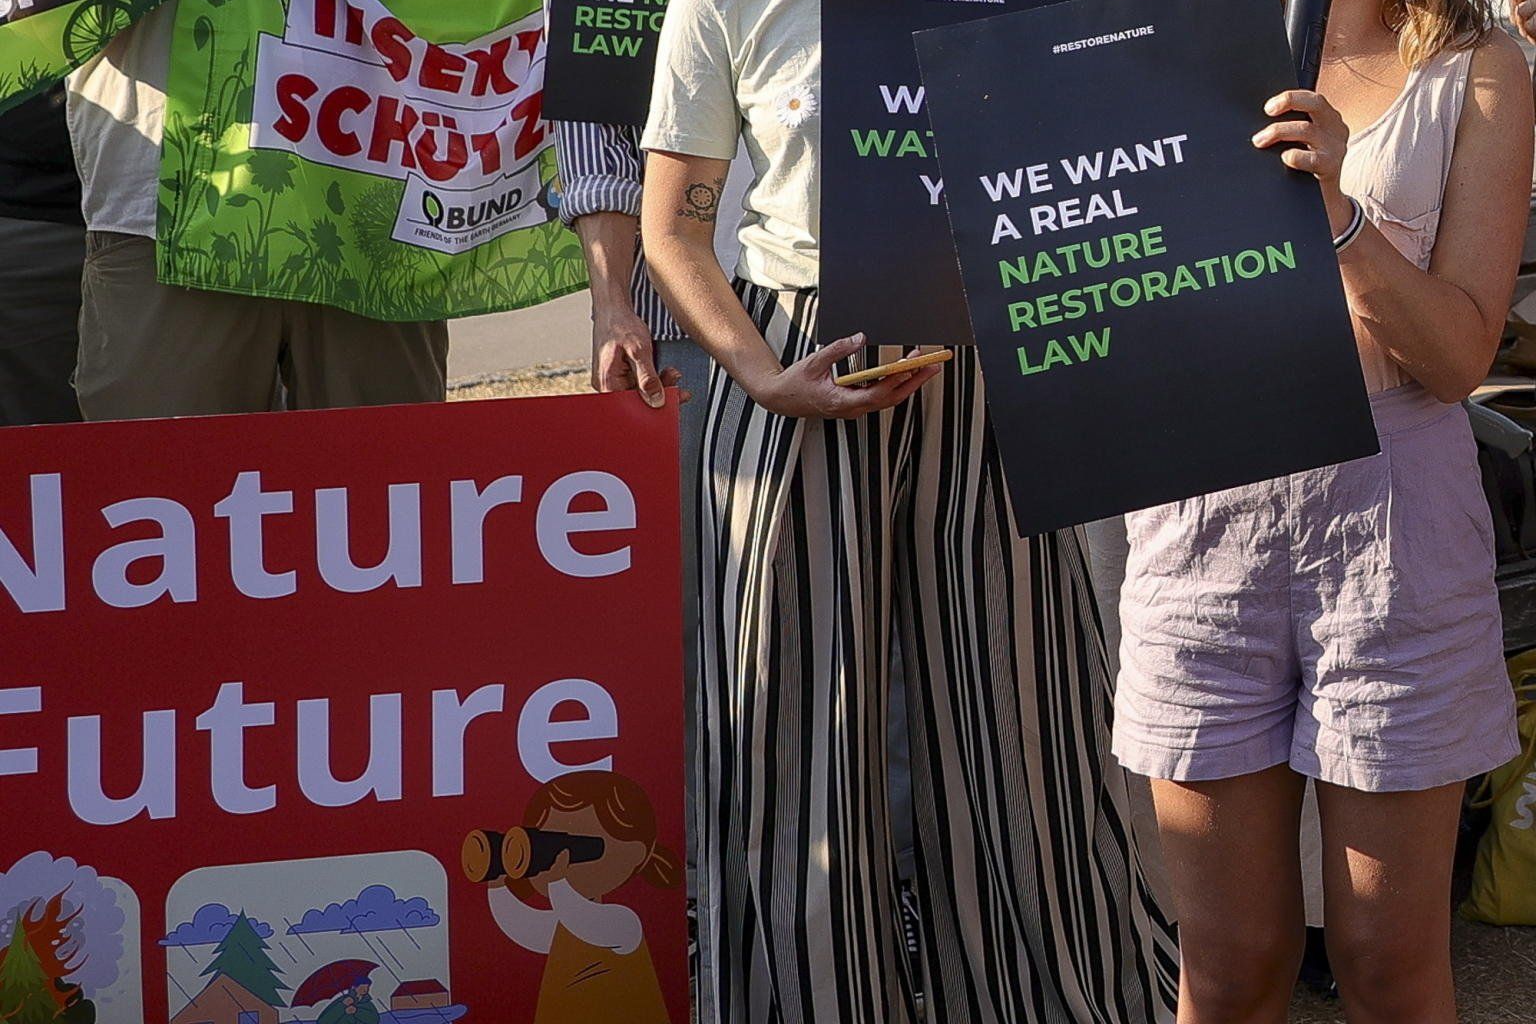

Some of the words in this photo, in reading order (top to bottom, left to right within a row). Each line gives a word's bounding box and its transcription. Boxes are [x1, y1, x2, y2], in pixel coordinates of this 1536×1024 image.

[572, 32, 643, 57] LAW
[1052, 25, 1155, 54] #RESTORENATURE
[980, 163, 1054, 203] WE
[1060, 134, 1188, 182] WANT
[447, 188, 522, 229] BUND
[990, 212, 1023, 245] A
[1031, 189, 1138, 236] REAL
[998, 225, 1167, 289] NATURE
[1006, 241, 1297, 332] RESTORATION
[1016, 327, 1112, 376] LAW
